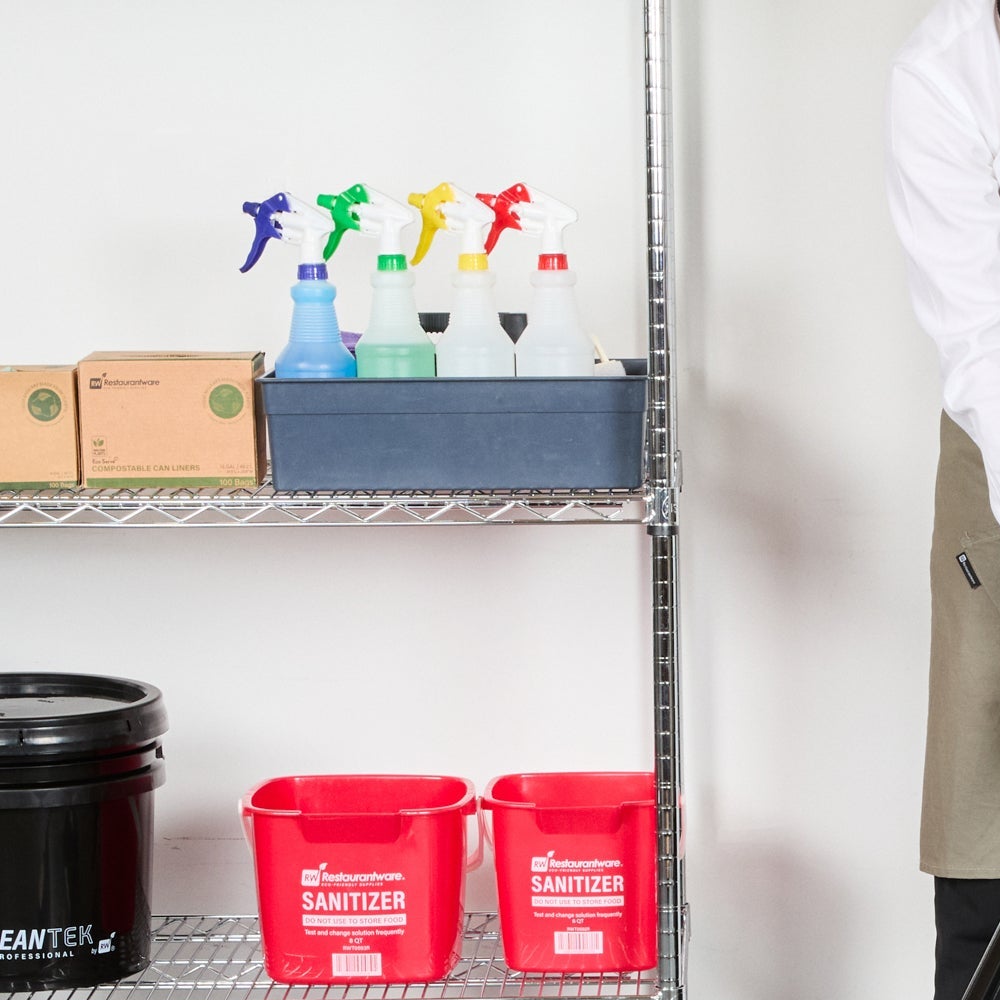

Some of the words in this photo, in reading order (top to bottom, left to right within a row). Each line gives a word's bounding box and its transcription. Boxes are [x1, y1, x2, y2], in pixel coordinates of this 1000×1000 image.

[103, 378, 160, 386] Restaurantware
[153, 464, 170, 472] CAN
[172, 464, 200, 472] LINERS
[531, 875, 624, 893] SANITIZER
[302, 891, 405, 911] SANITIZER
[360, 917, 381, 925] STORE
[375, 928, 405, 936] frequently
